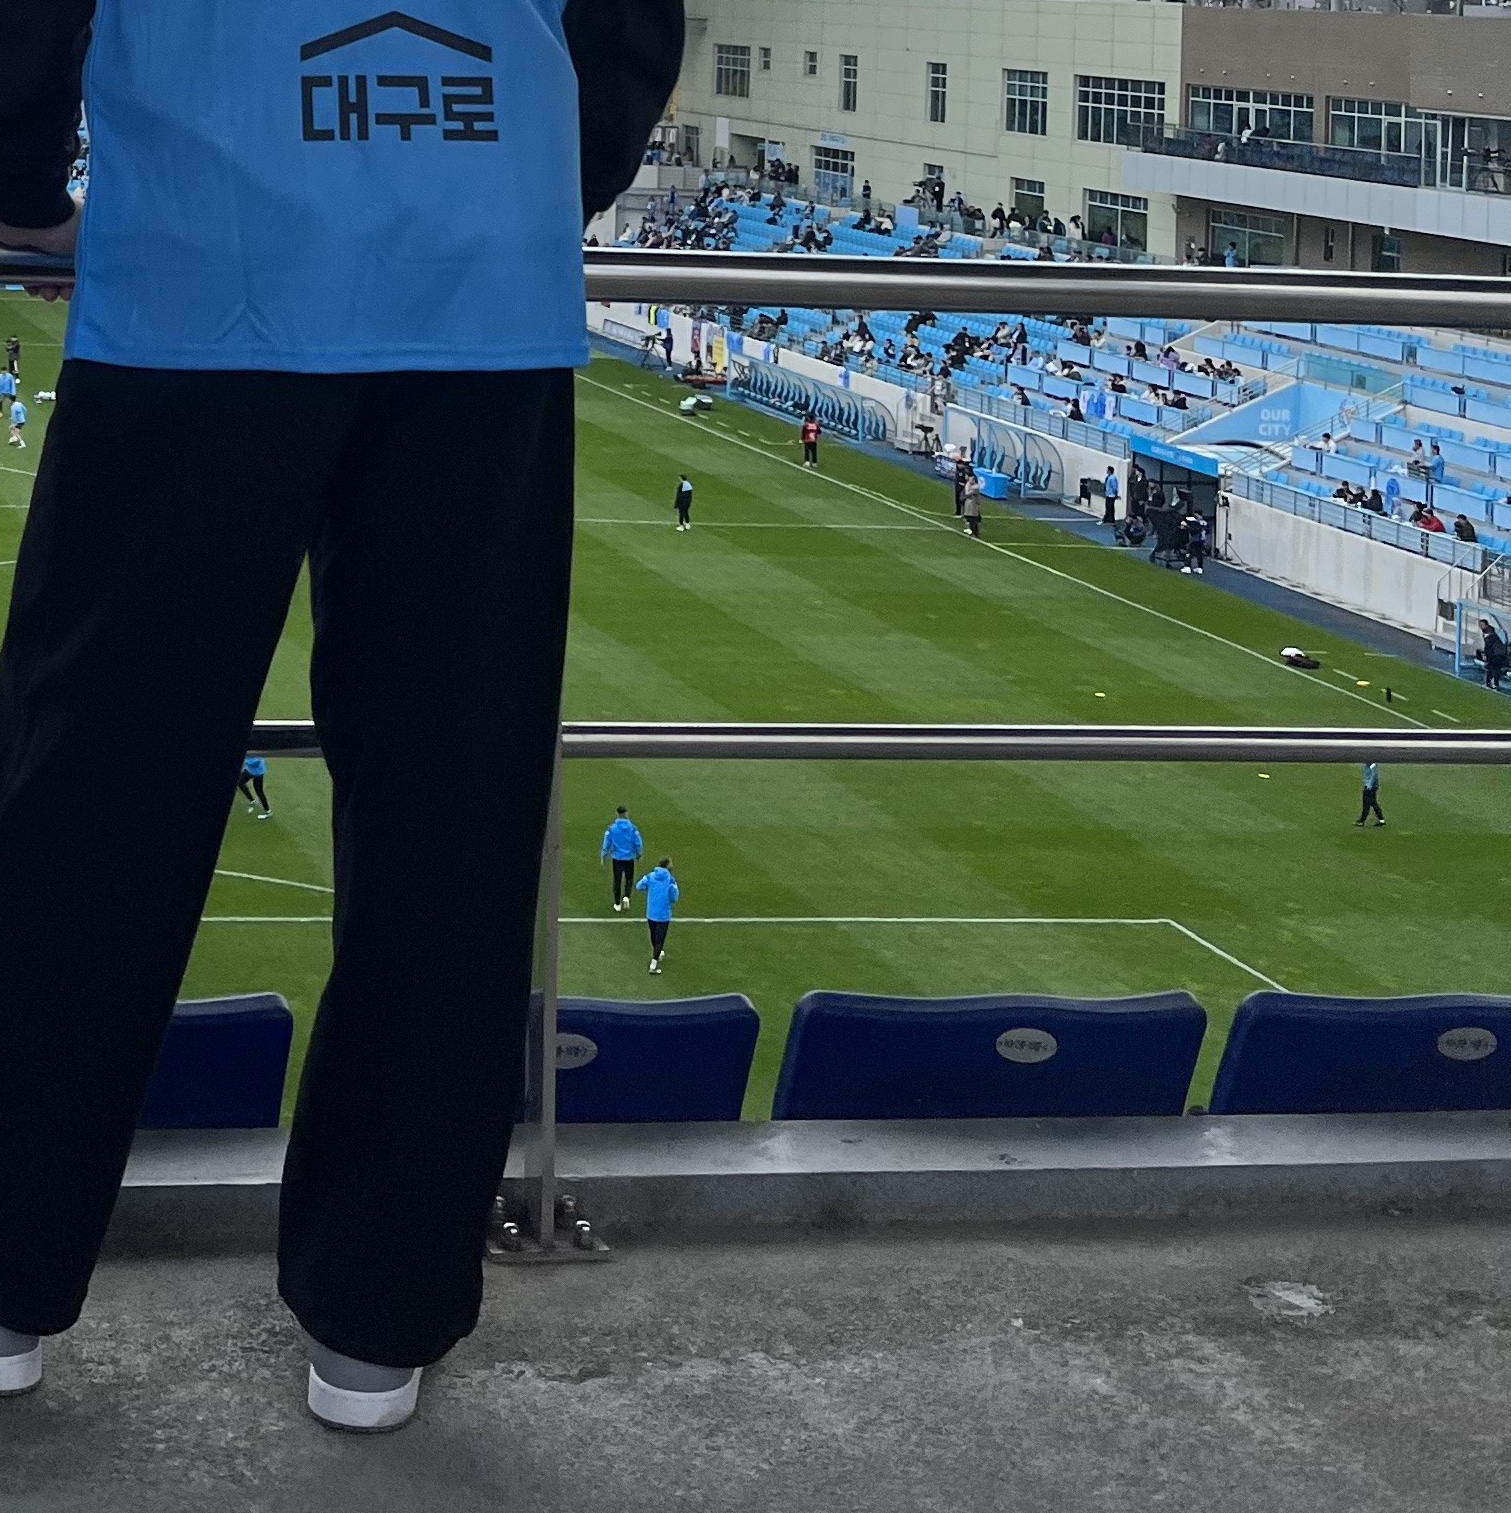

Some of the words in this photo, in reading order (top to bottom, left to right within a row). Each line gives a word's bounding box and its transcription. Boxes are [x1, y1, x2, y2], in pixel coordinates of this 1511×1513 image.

[300, 74, 499, 143] 대구로
[1260, 408, 1291, 422] OUR
[1259, 423, 1291, 437] CITY
